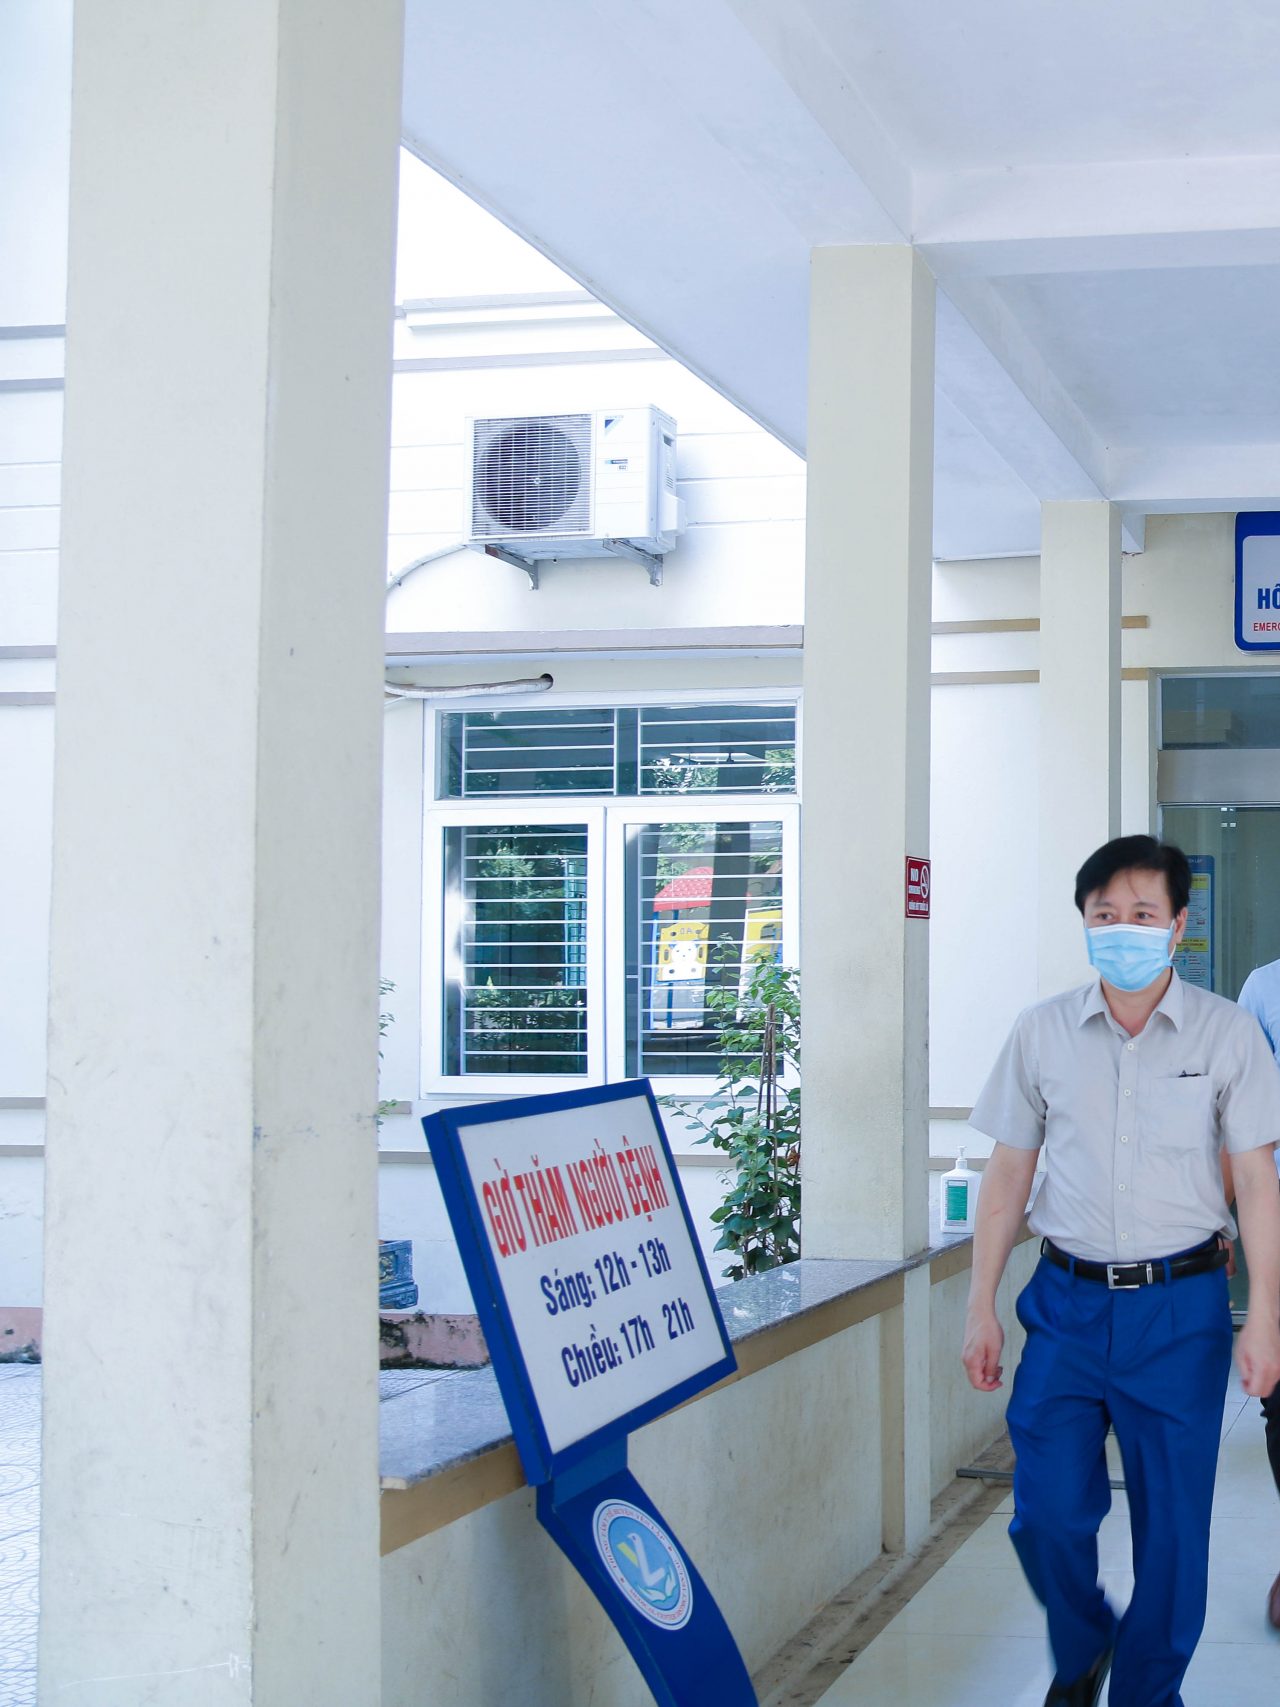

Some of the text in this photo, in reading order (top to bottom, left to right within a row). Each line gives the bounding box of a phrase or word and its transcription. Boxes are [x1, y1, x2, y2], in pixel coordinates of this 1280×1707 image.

[482, 1135, 670, 1258] GIỜ THĂM NGƯỜI BỆNH
[540, 1237, 672, 1316] Sáng: 12h - 13h
[561, 1297, 695, 1388] Chiều: 17h 21h
